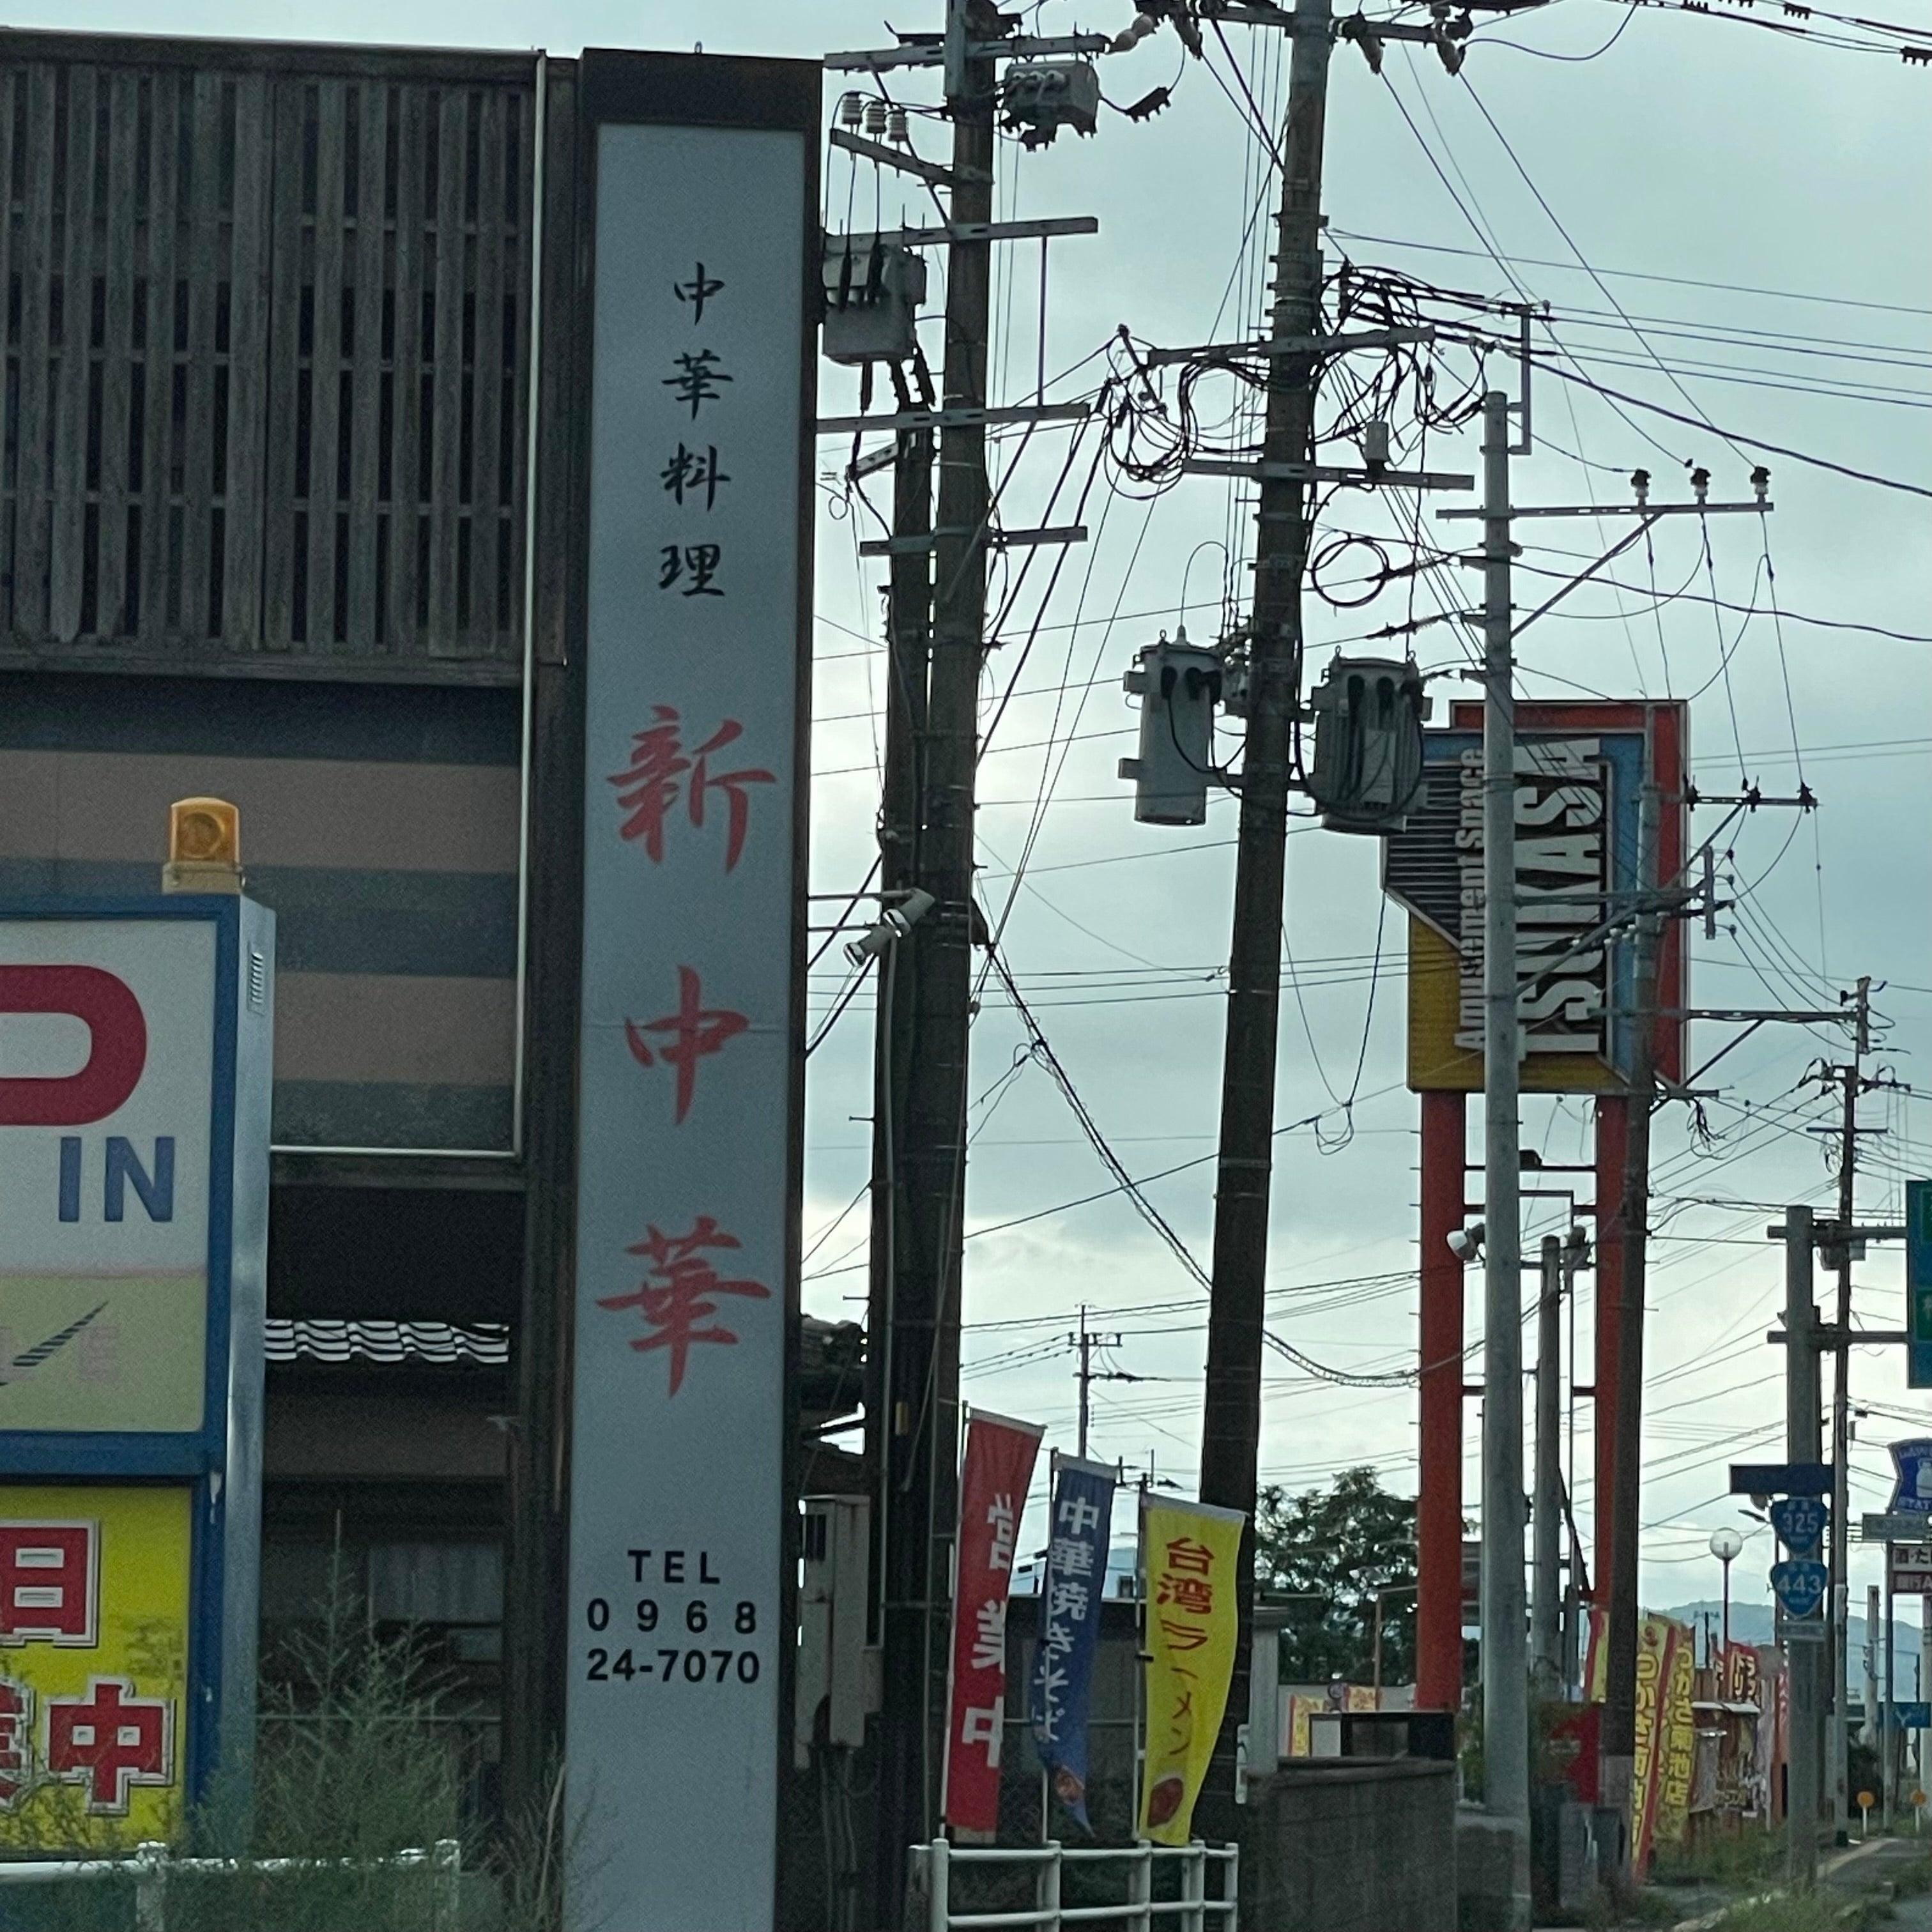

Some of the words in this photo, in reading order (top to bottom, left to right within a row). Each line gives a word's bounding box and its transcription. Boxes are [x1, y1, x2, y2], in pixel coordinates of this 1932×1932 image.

[658, 261, 733, 597] 中華料理
[595, 703, 778, 1399] 新中華
[58, 1136, 176, 1222] IN
[1897, 1496, 1932, 1511] STAT
[1782, 1512, 1819, 1534] 325
[627, 1549, 721, 1585] TEL
[1776, 1574, 1822, 1595] 443
[586, 1598, 756, 1634] 0968
[1156, 1537, 1215, 1756] 台湾ラーメン
[586, 1647, 760, 1684] 24-7070
